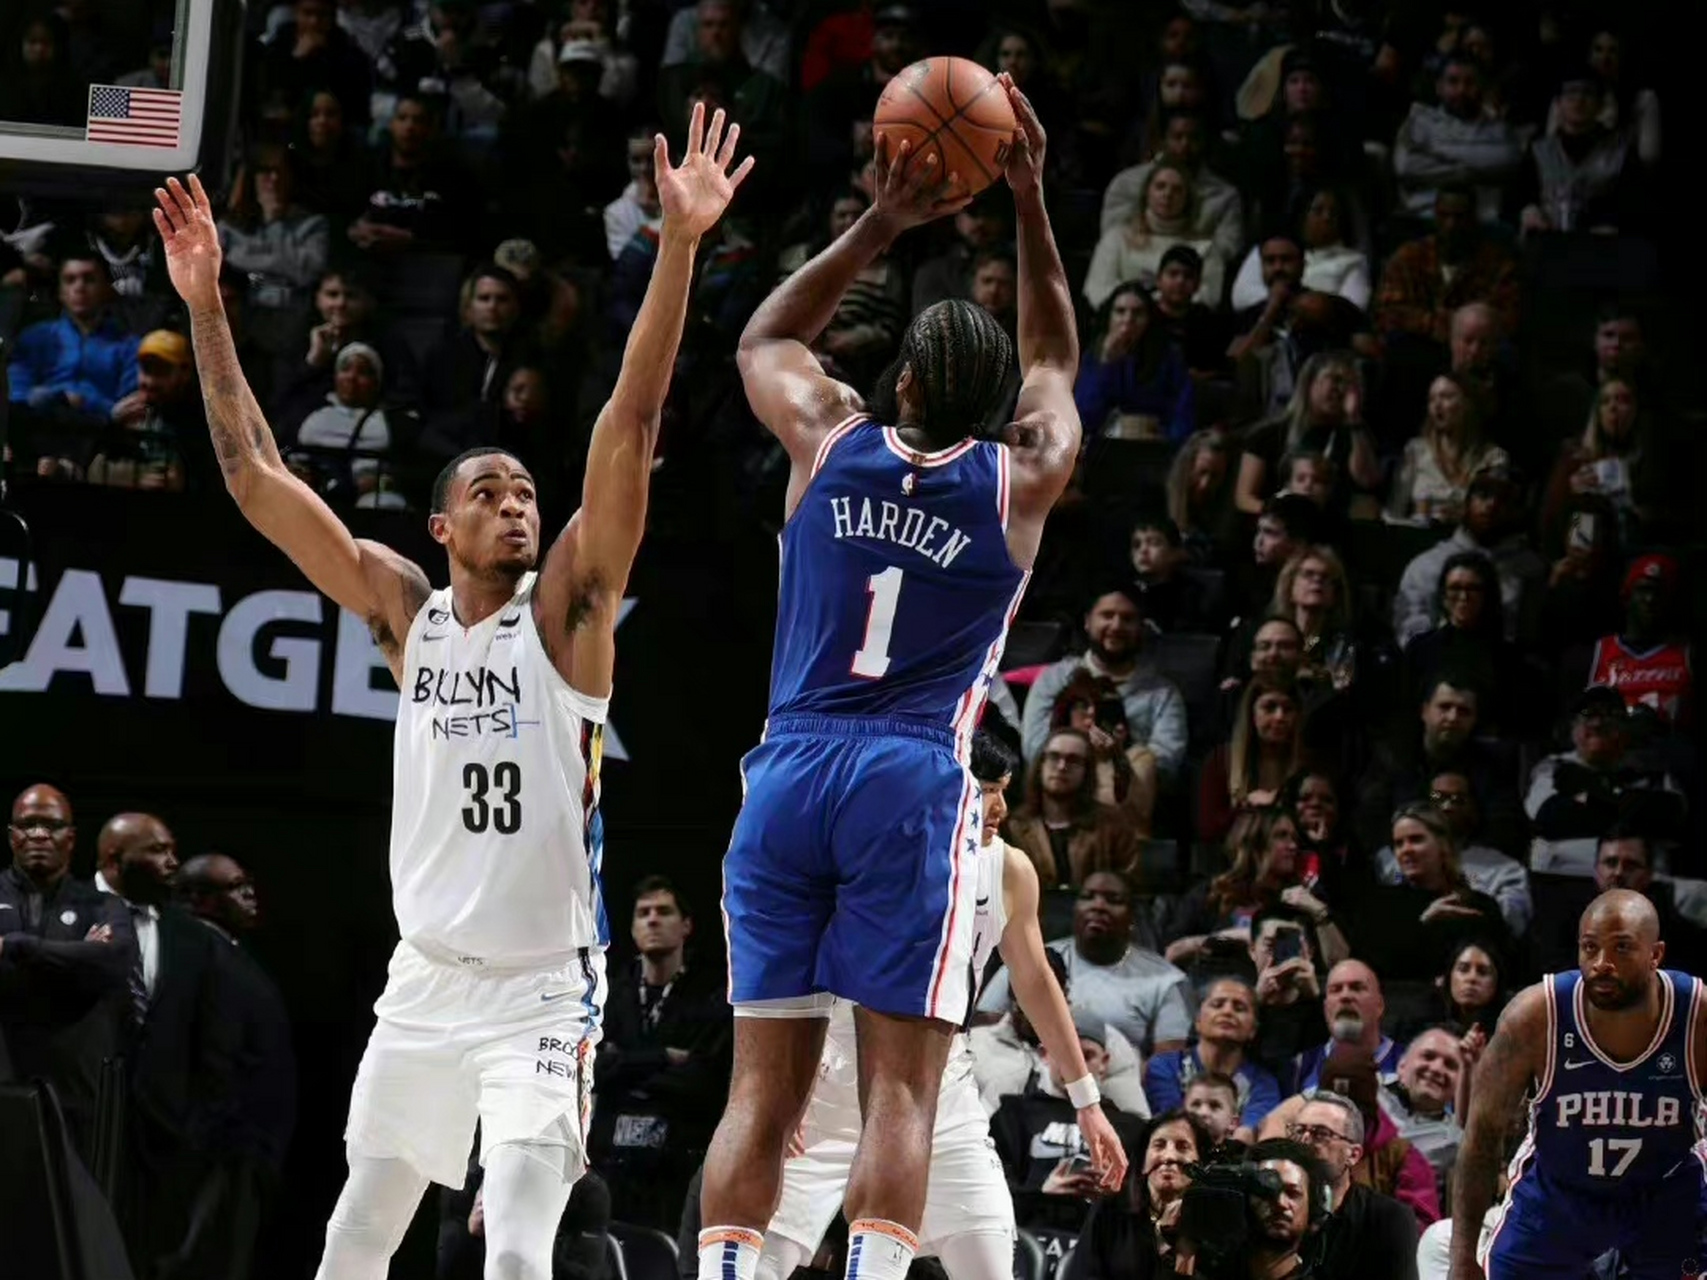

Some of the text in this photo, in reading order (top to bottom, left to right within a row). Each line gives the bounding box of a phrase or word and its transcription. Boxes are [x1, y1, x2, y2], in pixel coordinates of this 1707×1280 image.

[830, 496, 972, 569] HARDEN
[850, 565, 904, 681] 1
[432, 708, 511, 741] NETS
[461, 761, 523, 835] 33
[1563, 1032, 1575, 1049] 6
[1555, 1090, 1681, 1128] PHILA
[1587, 1137, 1644, 1177] 17
